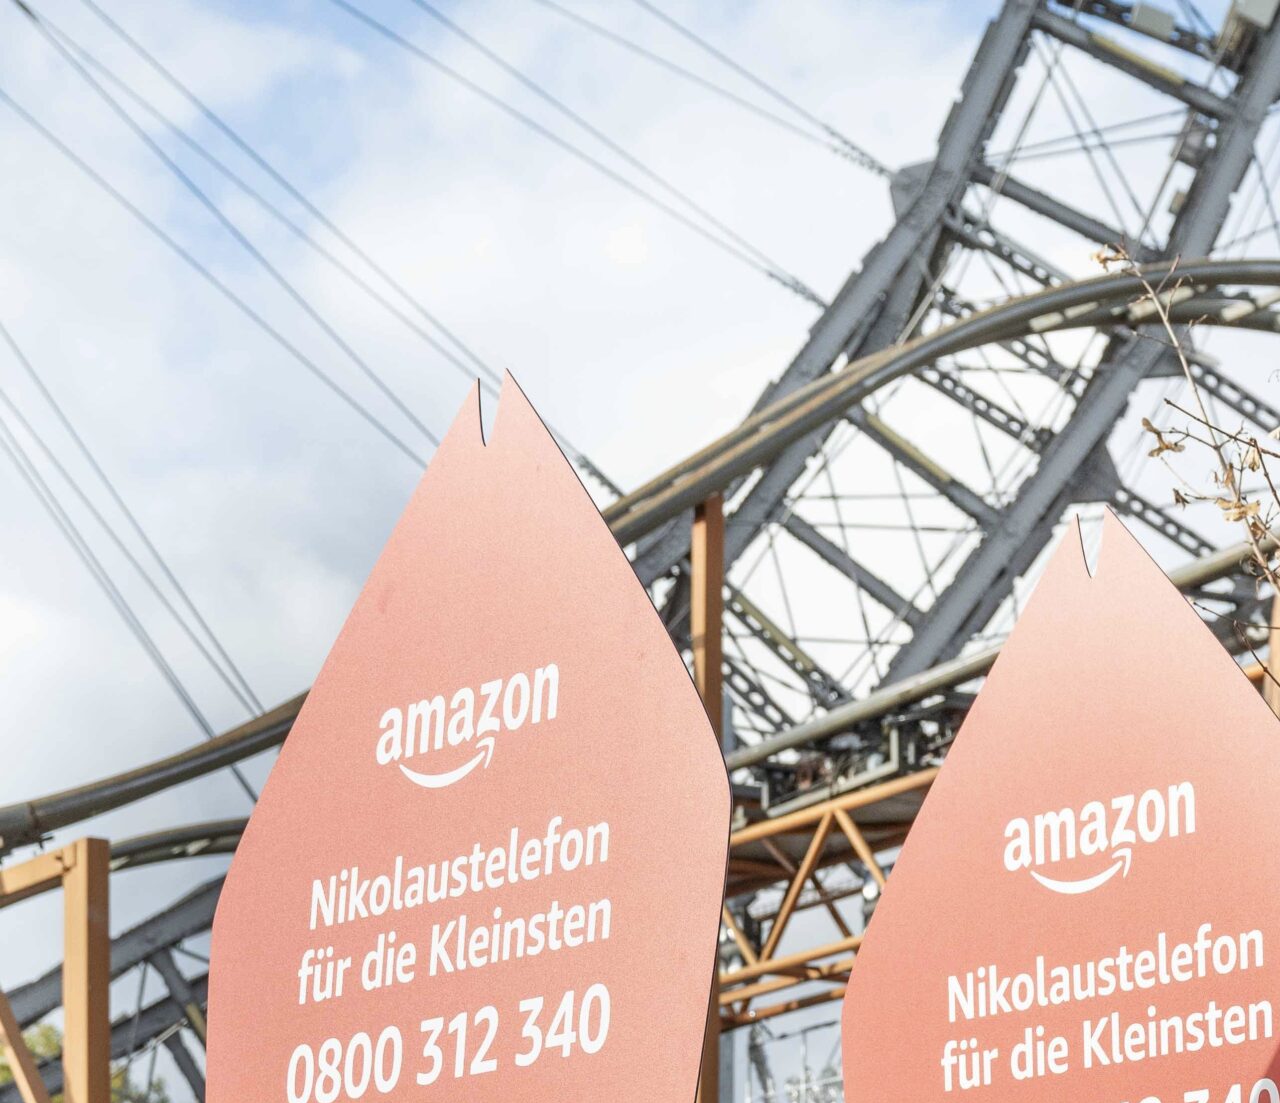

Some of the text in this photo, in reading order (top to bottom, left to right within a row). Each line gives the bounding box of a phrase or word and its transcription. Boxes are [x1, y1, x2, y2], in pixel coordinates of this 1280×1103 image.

[375, 663, 560, 766] amazon
[309, 815, 612, 931] Nikolaustelefon
[1002, 780, 1197, 872] amazon
[297, 897, 612, 1005] für die Kleinsten
[947, 922, 1265, 1024] Nikolaustelefon
[415, 1004, 500, 1086] 312
[514, 982, 612, 1068] 340
[940, 999, 1274, 1093] für die Kleinsten
